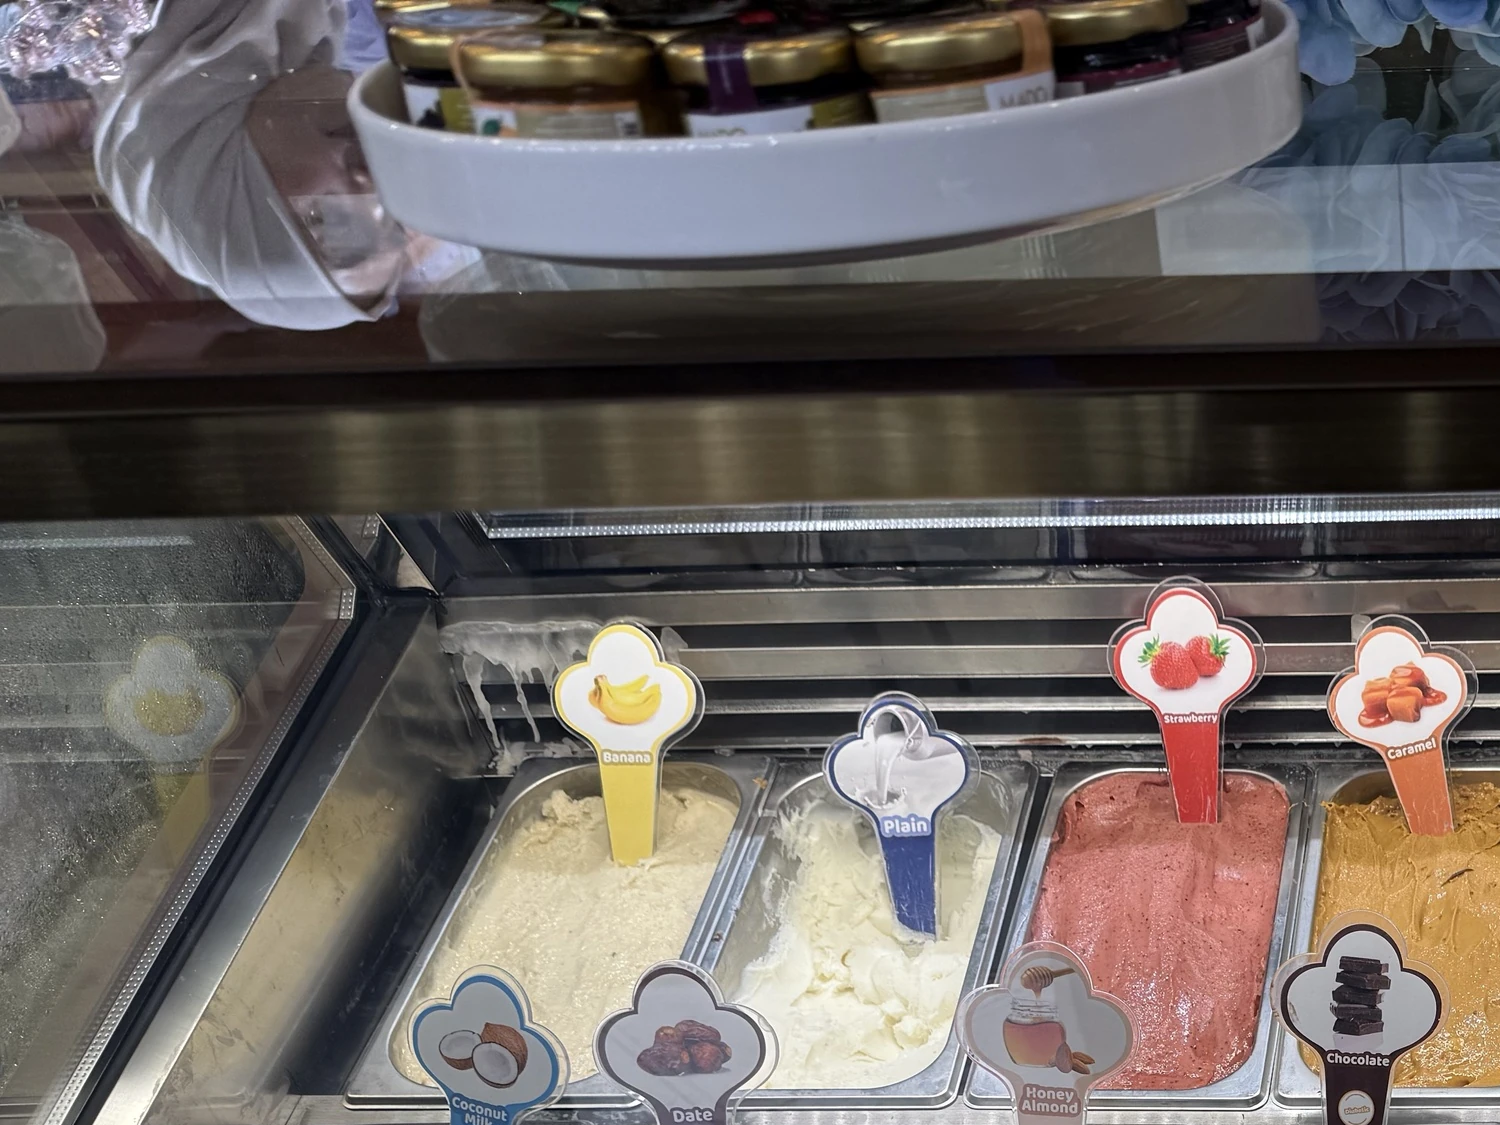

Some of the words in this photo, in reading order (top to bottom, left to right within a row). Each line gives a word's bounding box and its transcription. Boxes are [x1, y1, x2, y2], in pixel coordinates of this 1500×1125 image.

[1164, 713, 1219, 725] Strawberry
[1386, 739, 1437, 760] Caramel
[603, 752, 652, 764] Banana
[883, 817, 928, 834] Plain
[1325, 1053, 1389, 1068] Chocolate
[1025, 1087, 1074, 1103] Honey
[452, 1096, 508, 1122] Coconut
[1022, 1100, 1077, 1115] Almond
[673, 1109, 713, 1122] Date
